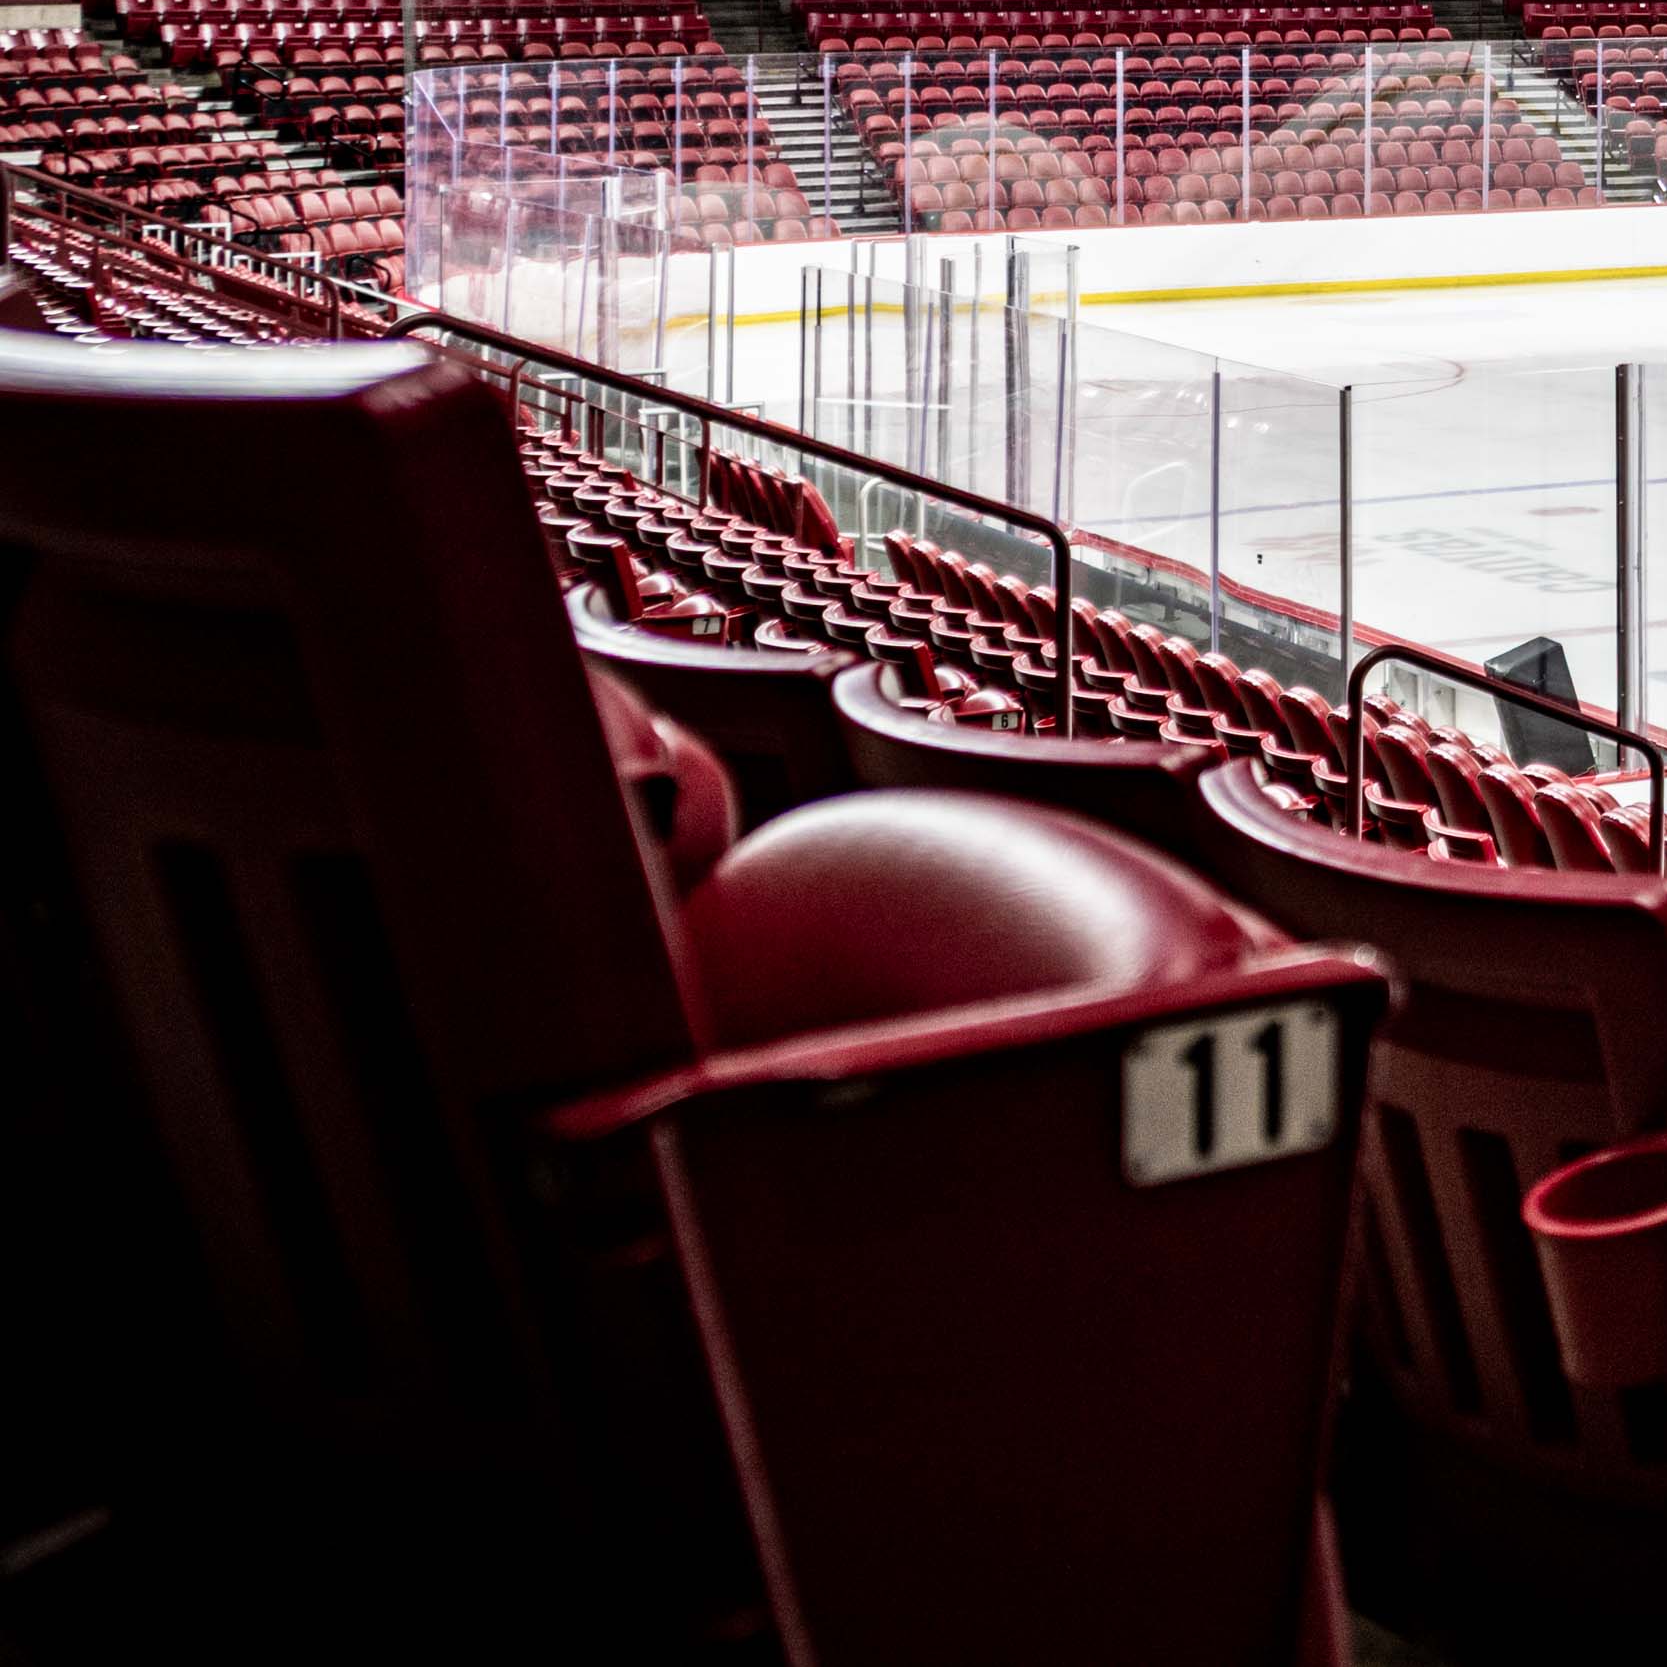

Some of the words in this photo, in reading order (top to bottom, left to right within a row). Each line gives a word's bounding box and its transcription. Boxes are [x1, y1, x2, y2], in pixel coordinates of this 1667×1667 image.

[704, 618, 710, 633] 7
[1001, 714, 1008, 728] 6
[1178, 1020, 1285, 1160] 11
